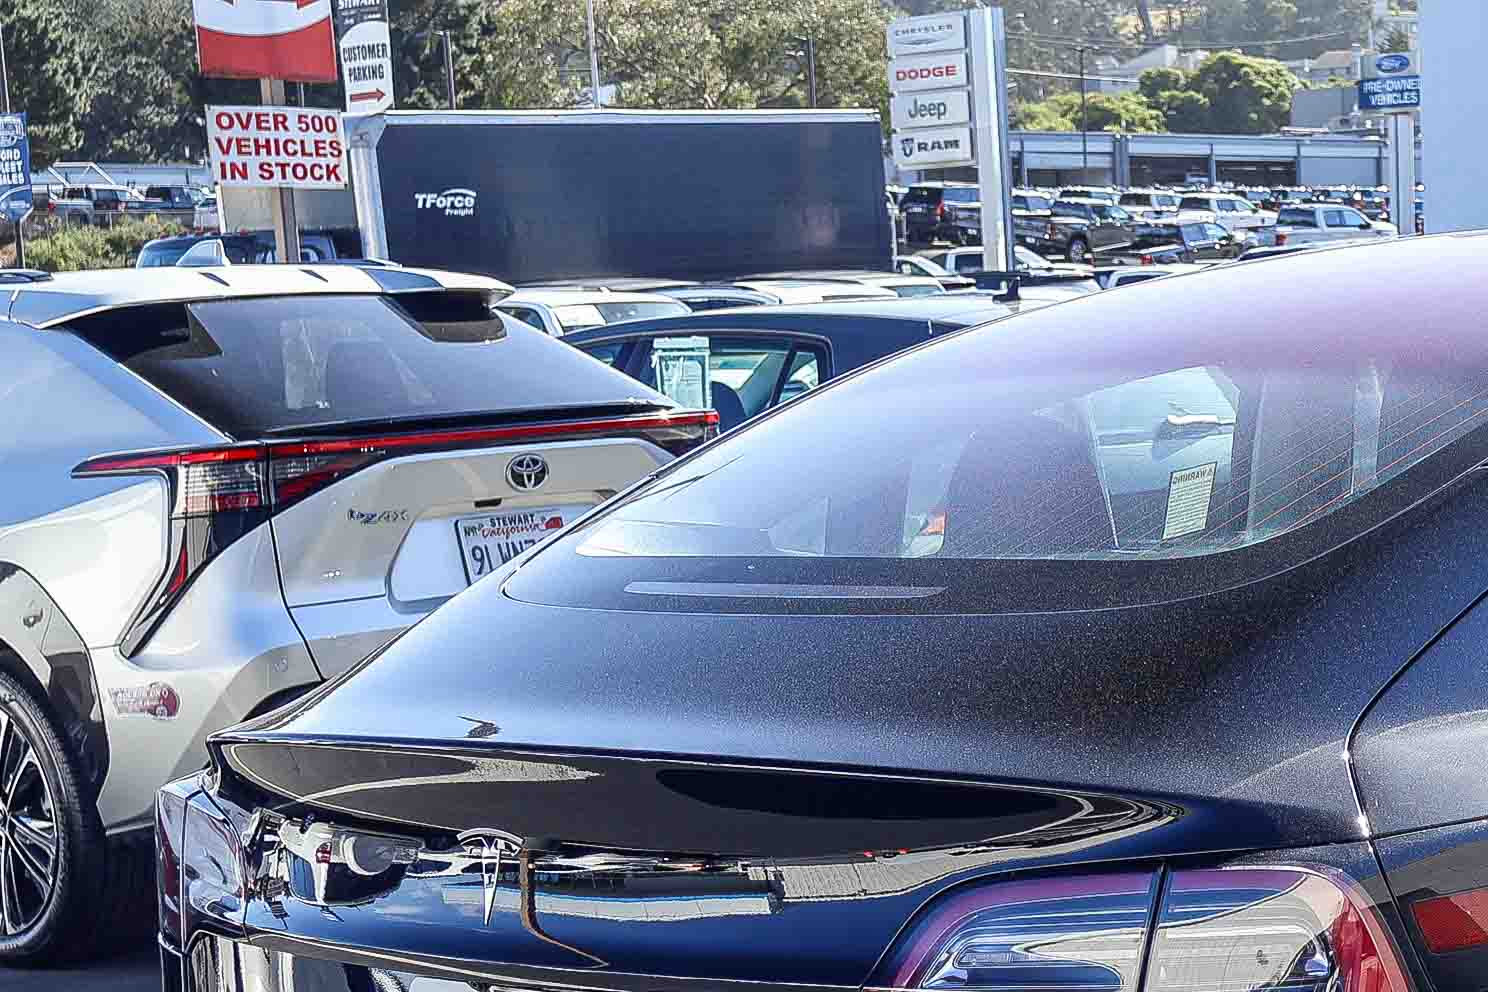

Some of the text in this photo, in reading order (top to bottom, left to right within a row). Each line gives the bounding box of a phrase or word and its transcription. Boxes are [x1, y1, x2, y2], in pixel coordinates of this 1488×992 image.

[896, 24, 953, 36] CHRYSLER
[343, 43, 387, 62] CUSTOMER
[349, 63, 385, 82] PARKING
[896, 65, 957, 81] DODGE
[1368, 91, 1418, 105] VEHICLES
[908, 97, 947, 120] Jeep
[215, 111, 337, 133] OVER 500
[214, 136, 342, 158] VEHICLES
[917, 139, 960, 152] RAM
[0, 160, 23, 173] LEET
[220, 160, 341, 182] IN STOCK
[414, 192, 475, 208] TForce
[489, 513, 535, 527] STEWART
